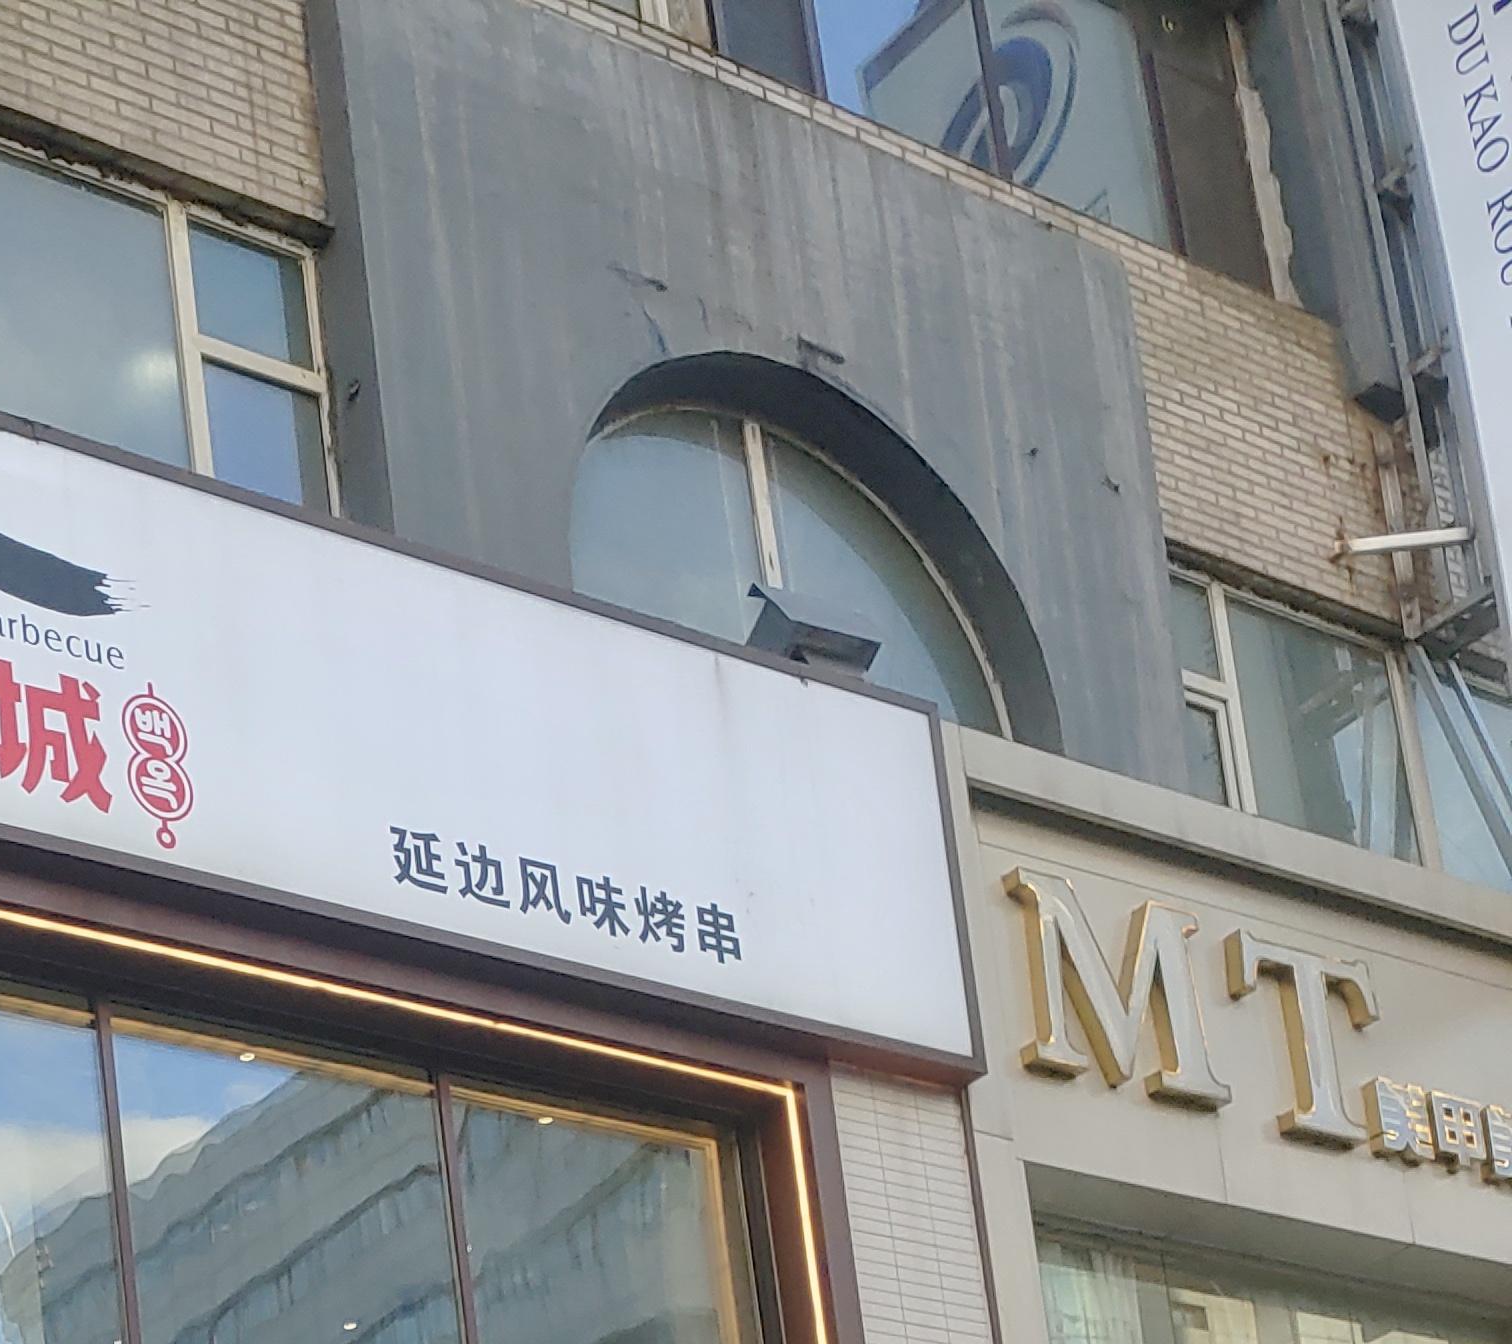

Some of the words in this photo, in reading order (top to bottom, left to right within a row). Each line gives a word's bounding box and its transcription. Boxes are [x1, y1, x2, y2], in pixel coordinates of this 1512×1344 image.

[1447, 3, 1490, 76] DU
[1463, 73, 1510, 173] KAO
[389, 825, 743, 965] 延边风味烤串
[1002, 867, 1381, 1152] MT
